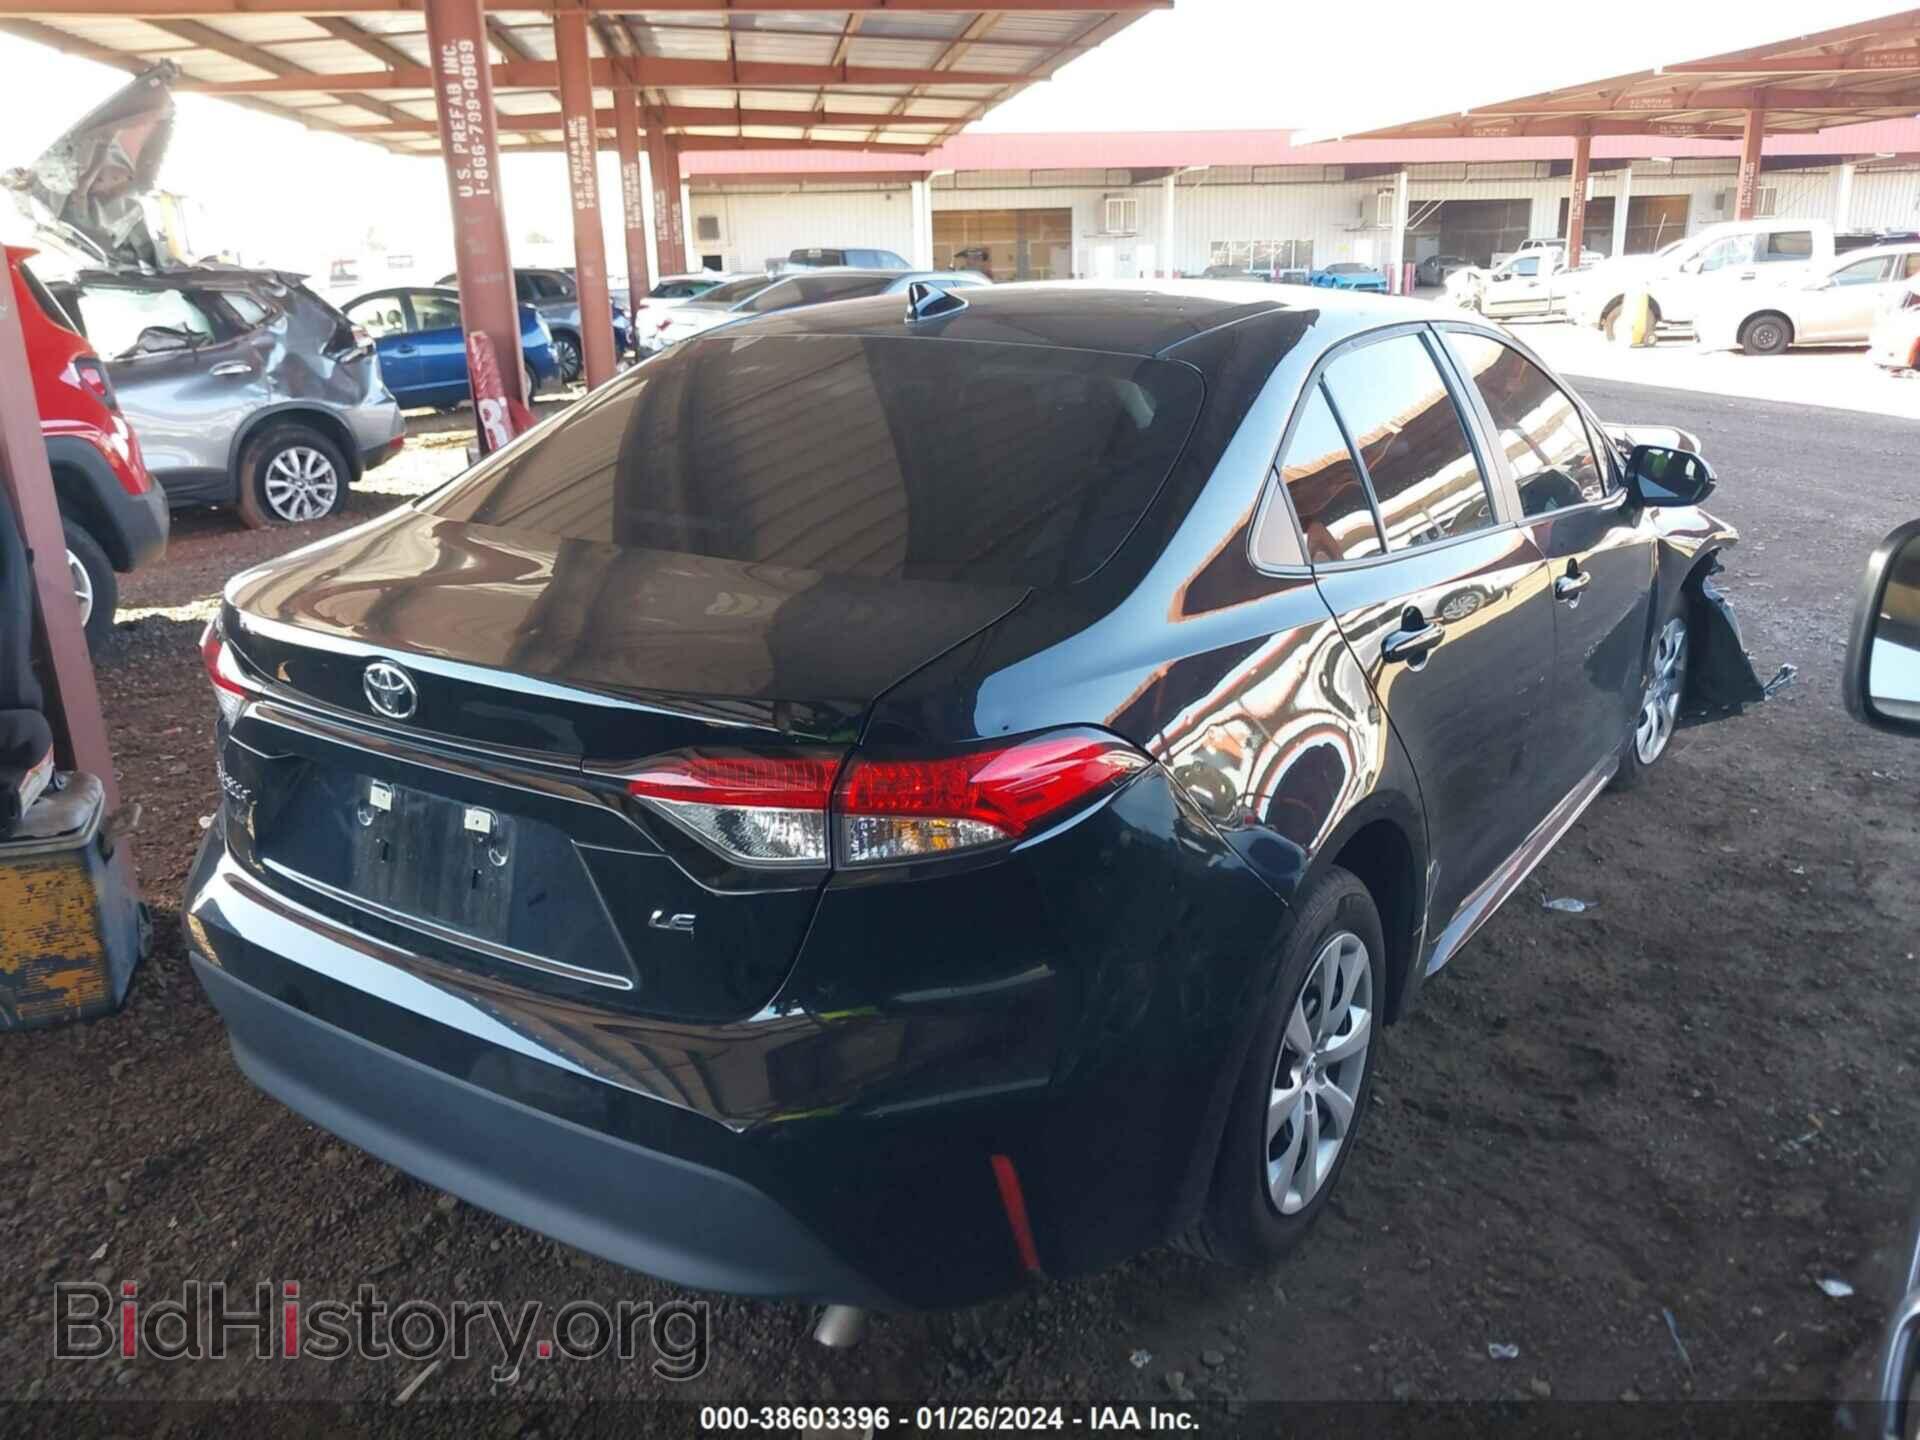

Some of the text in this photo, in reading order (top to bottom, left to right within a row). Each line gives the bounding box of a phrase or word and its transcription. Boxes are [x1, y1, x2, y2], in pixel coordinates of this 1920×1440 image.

[441, 39, 474, 197] U.S. PREFAB INC.
[458, 40, 491, 195] 1-866-799-0969
[648, 909, 696, 934] LE
